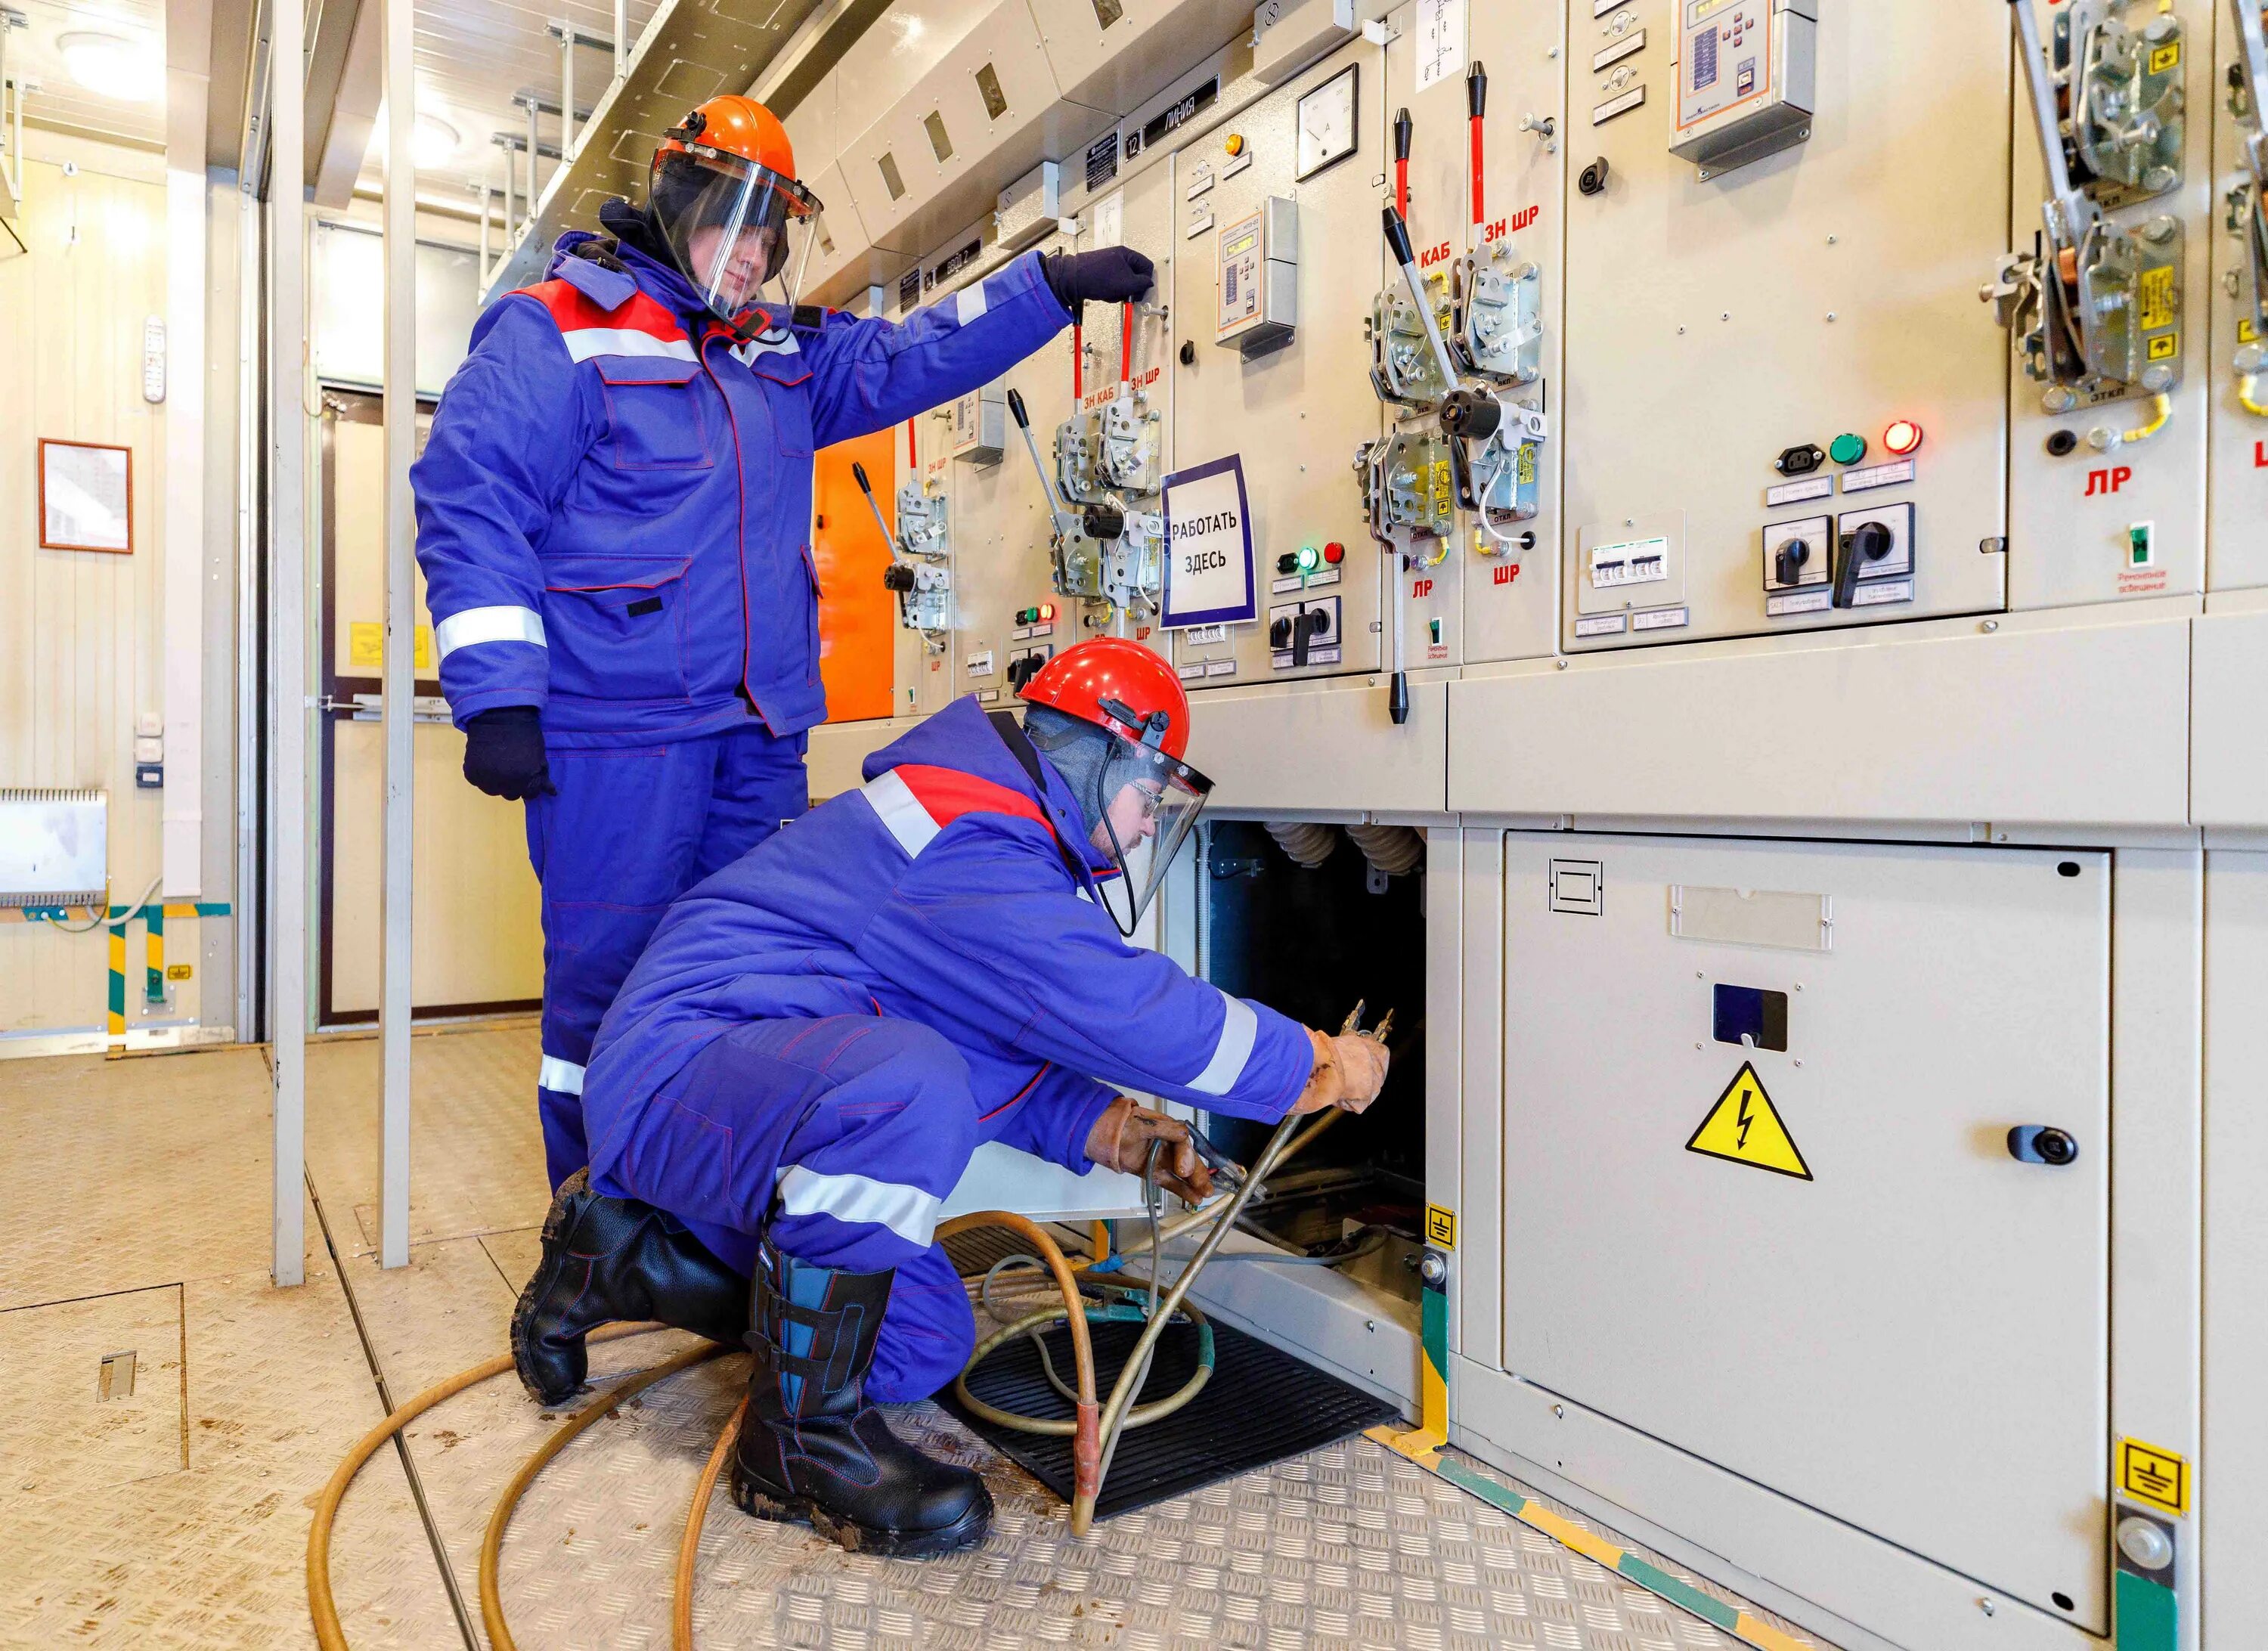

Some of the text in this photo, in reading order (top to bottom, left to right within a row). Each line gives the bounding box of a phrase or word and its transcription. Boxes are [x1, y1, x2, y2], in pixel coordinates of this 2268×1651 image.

[1164, 96, 1194, 131] ЛИНИЯ
[1128, 136, 1138, 156] 12
[1485, 205, 1539, 243] ЗН ШР
[963, 249, 968, 264] 2
[1421, 241, 1450, 268] КАБ
[1130, 367, 1160, 391] ЗН ШР
[1498, 379, 1511, 387] ВКЛ
[1084, 386, 1114, 409] ЗН КАБ
[937, 457, 947, 470] ШР
[2084, 466, 2133, 497] ЛР
[1173, 511, 1238, 541] РАБОТАТЬ
[1493, 513, 1511, 522] ОТКЛ
[1185, 550, 1226, 575] ЗДЕСЬ
[1493, 564, 1520, 585] ШР
[1413, 579, 1433, 598] ЛР
[1136, 627, 1151, 640] ШР
[931, 658, 943, 674] ШР
